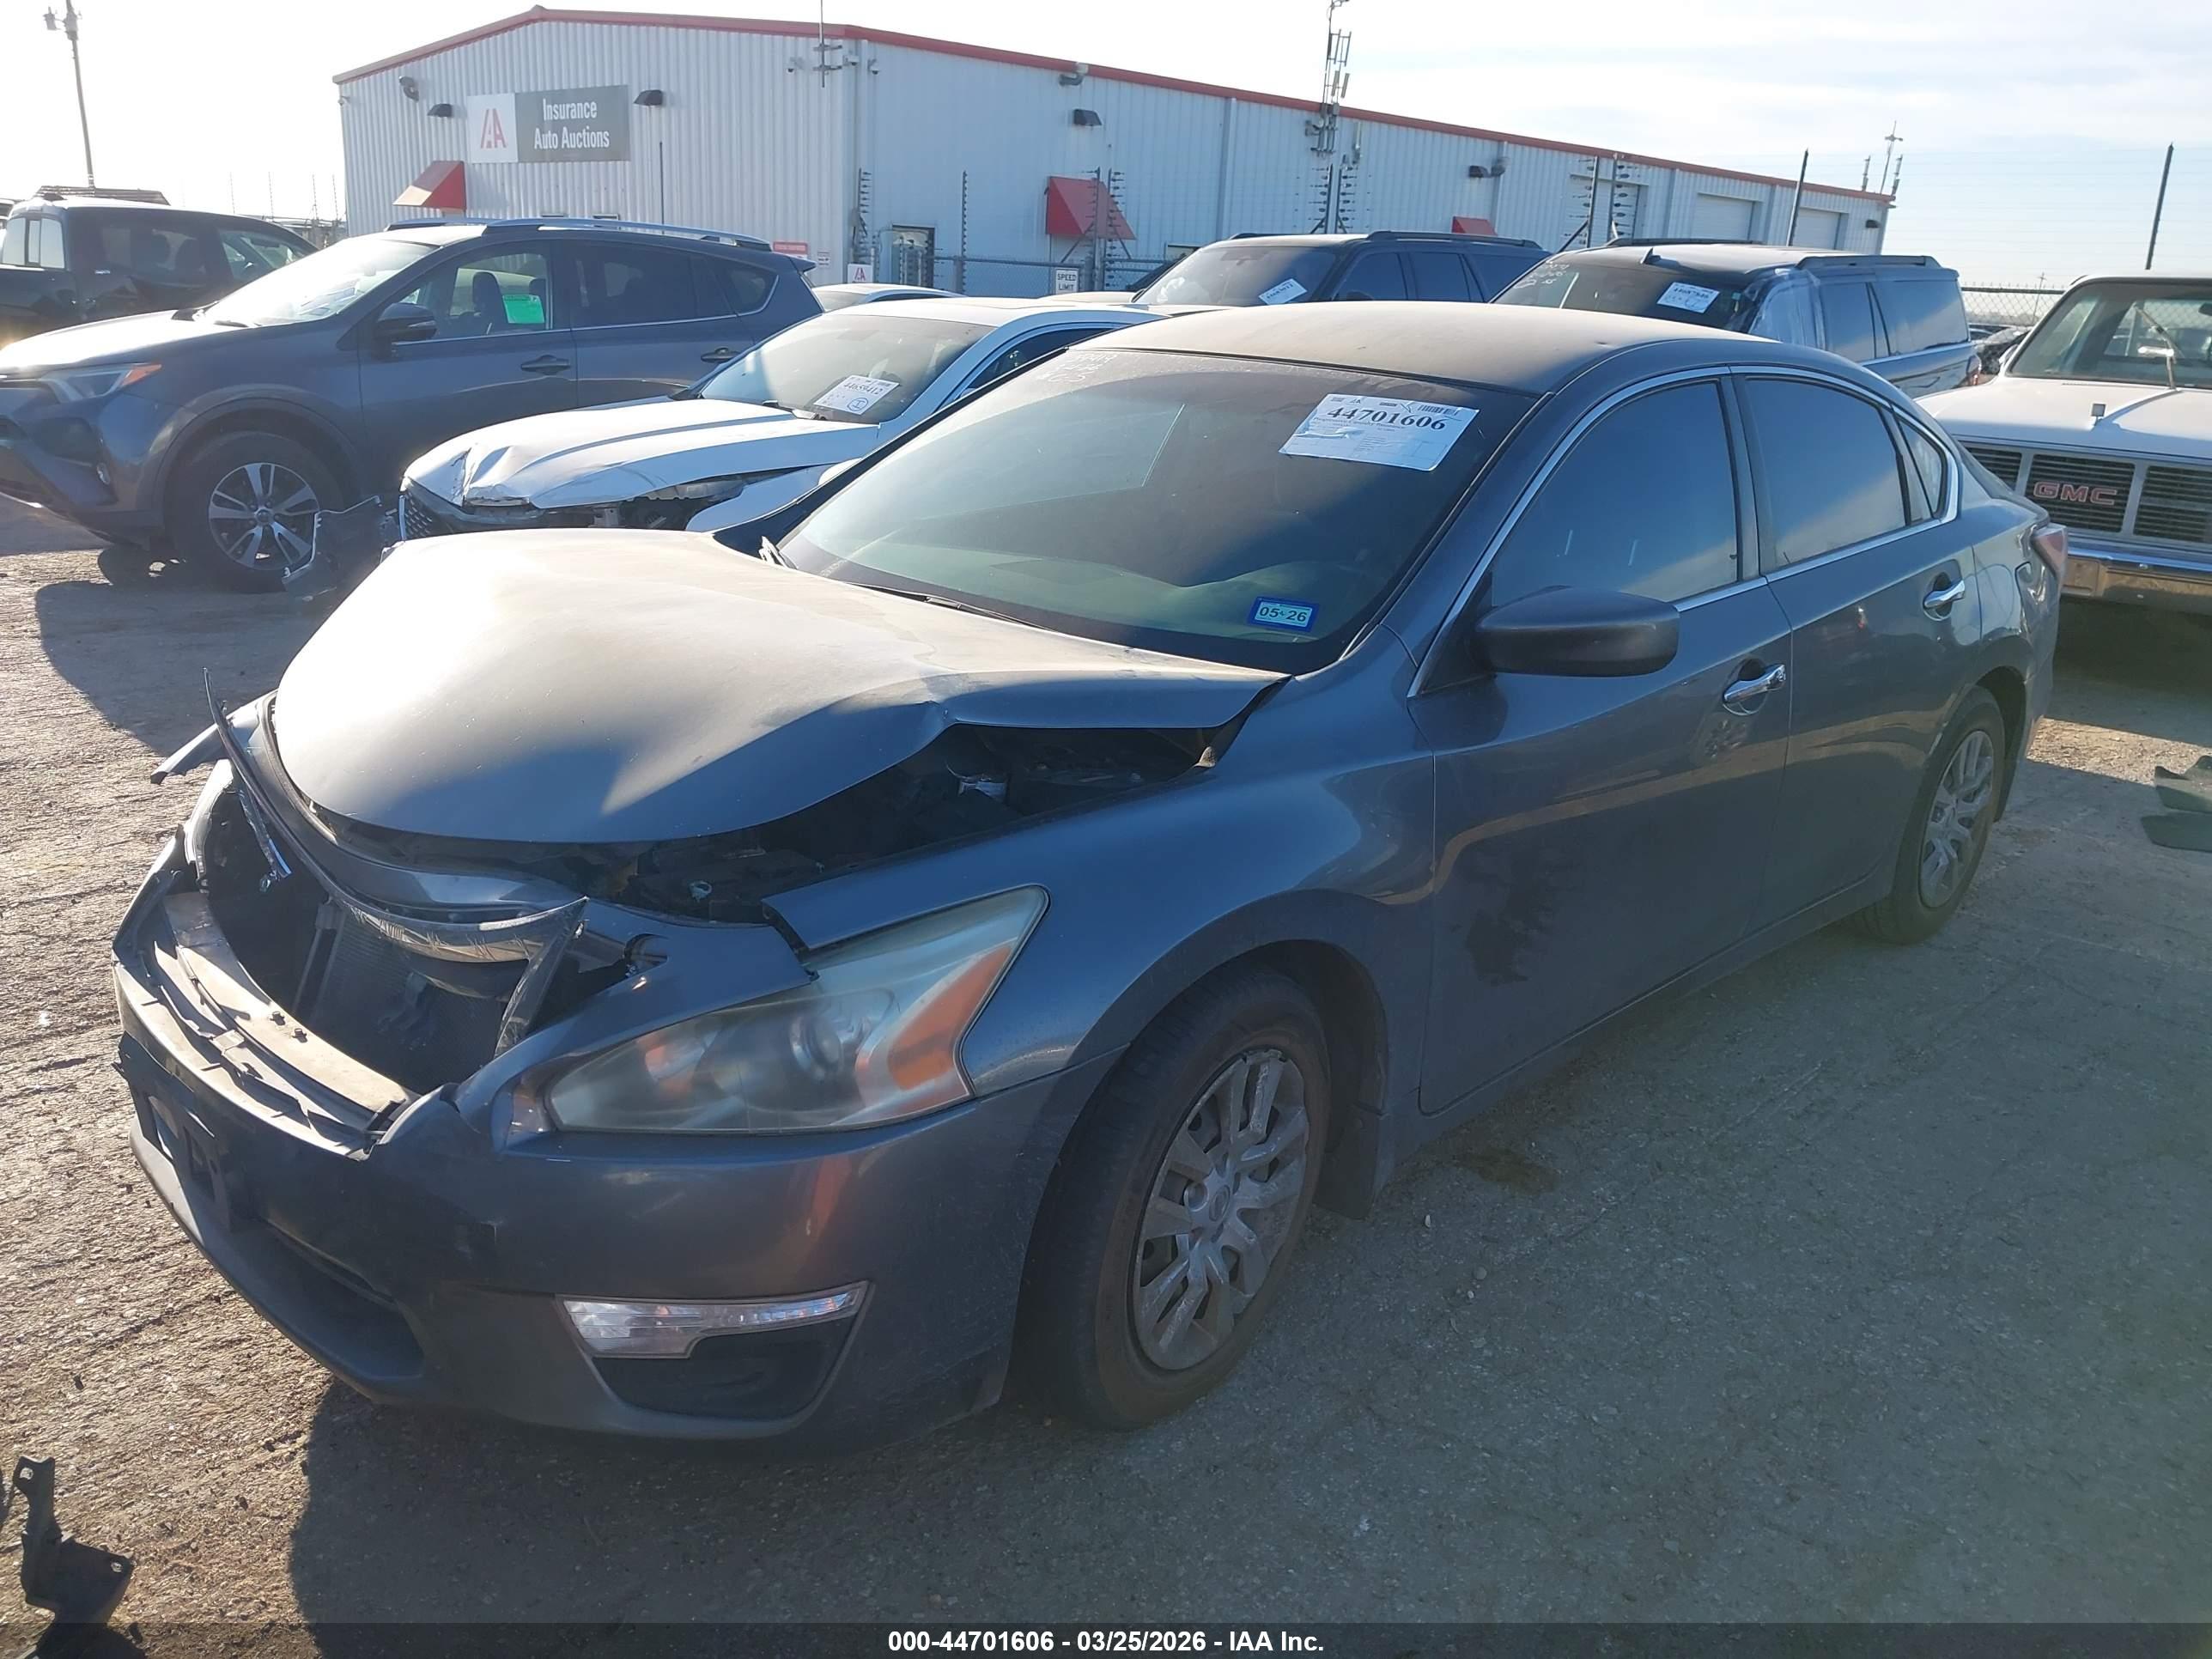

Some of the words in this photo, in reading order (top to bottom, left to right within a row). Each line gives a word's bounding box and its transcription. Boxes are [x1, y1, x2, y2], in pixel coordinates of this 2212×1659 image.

[543, 99, 597, 120] Insurance
[534, 127, 558, 149] Auto
[562, 126, 610, 149] Auctions
[1328, 406, 1447, 429] 44701606
[2033, 481, 2118, 506] GMC
[1260, 606, 1279, 617] 05
[1286, 610, 1307, 622] 26
